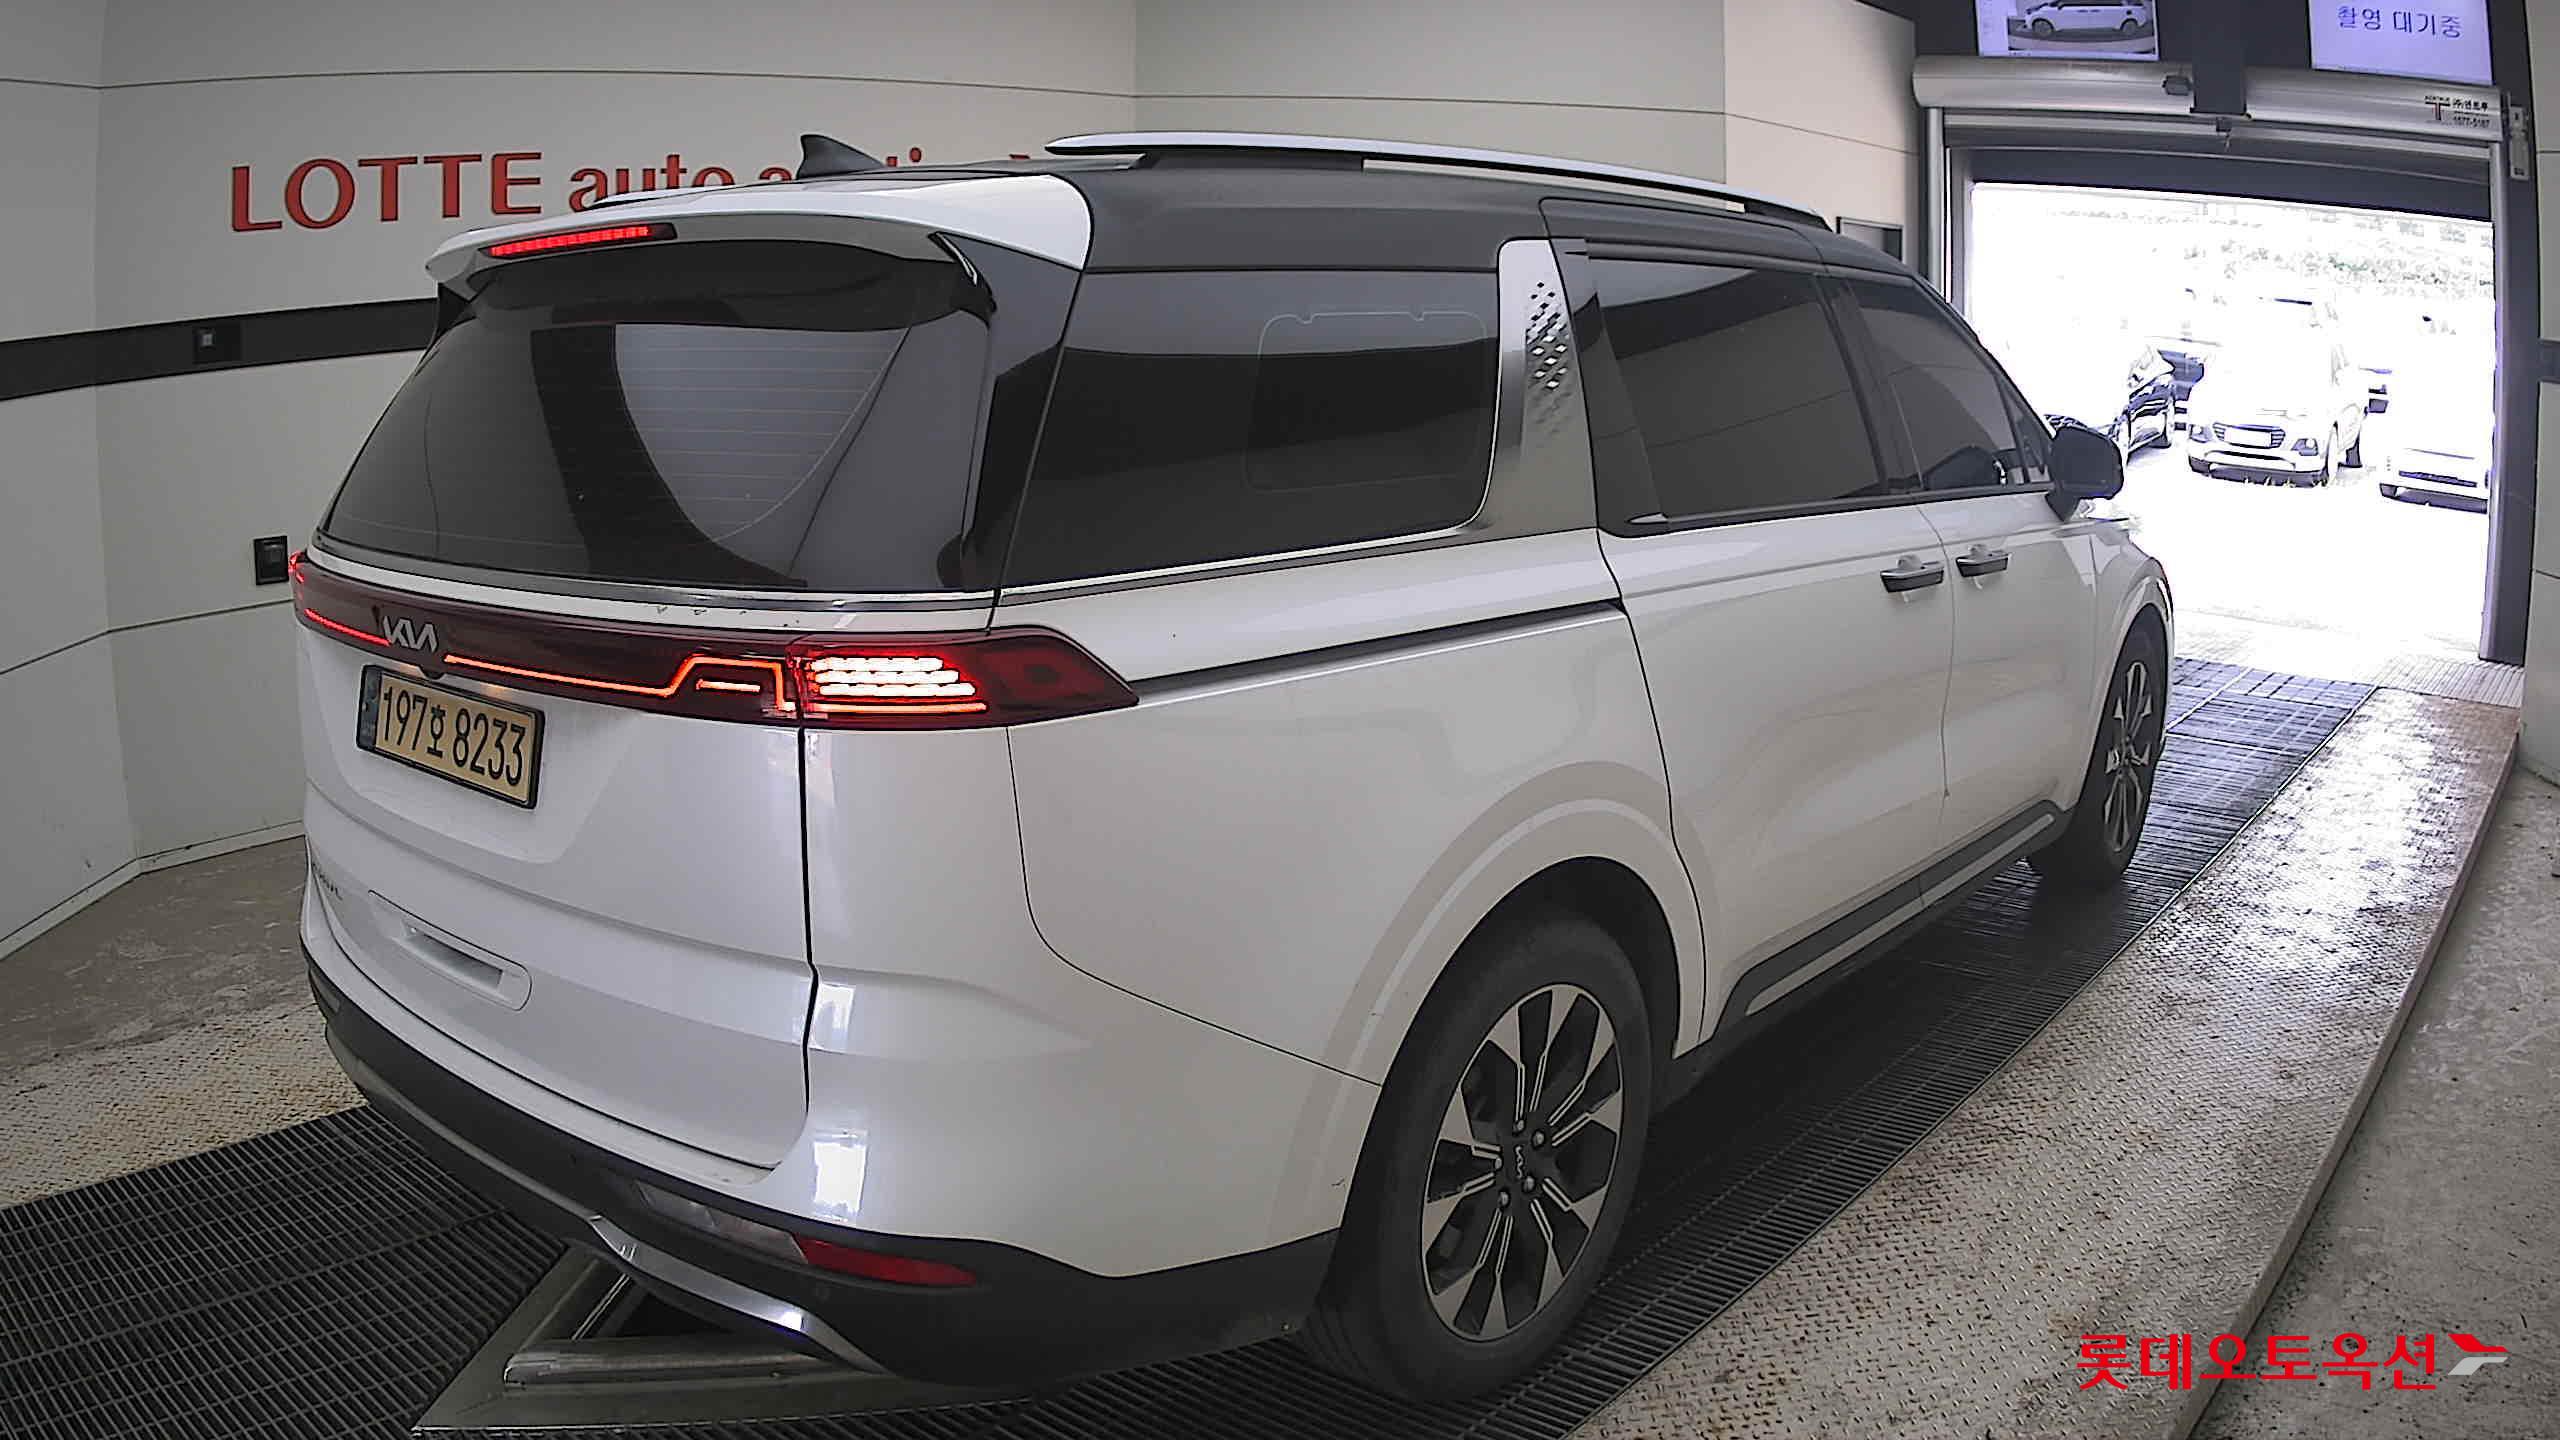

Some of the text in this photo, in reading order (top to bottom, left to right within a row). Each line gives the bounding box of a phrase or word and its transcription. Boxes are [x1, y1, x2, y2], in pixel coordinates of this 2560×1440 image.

[2338, 6, 2462, 39] 촬영 대기중
[232, 152, 542, 232] LOTTE
[382, 615, 438, 652] KIA
[453, 708, 527, 786] 8233
